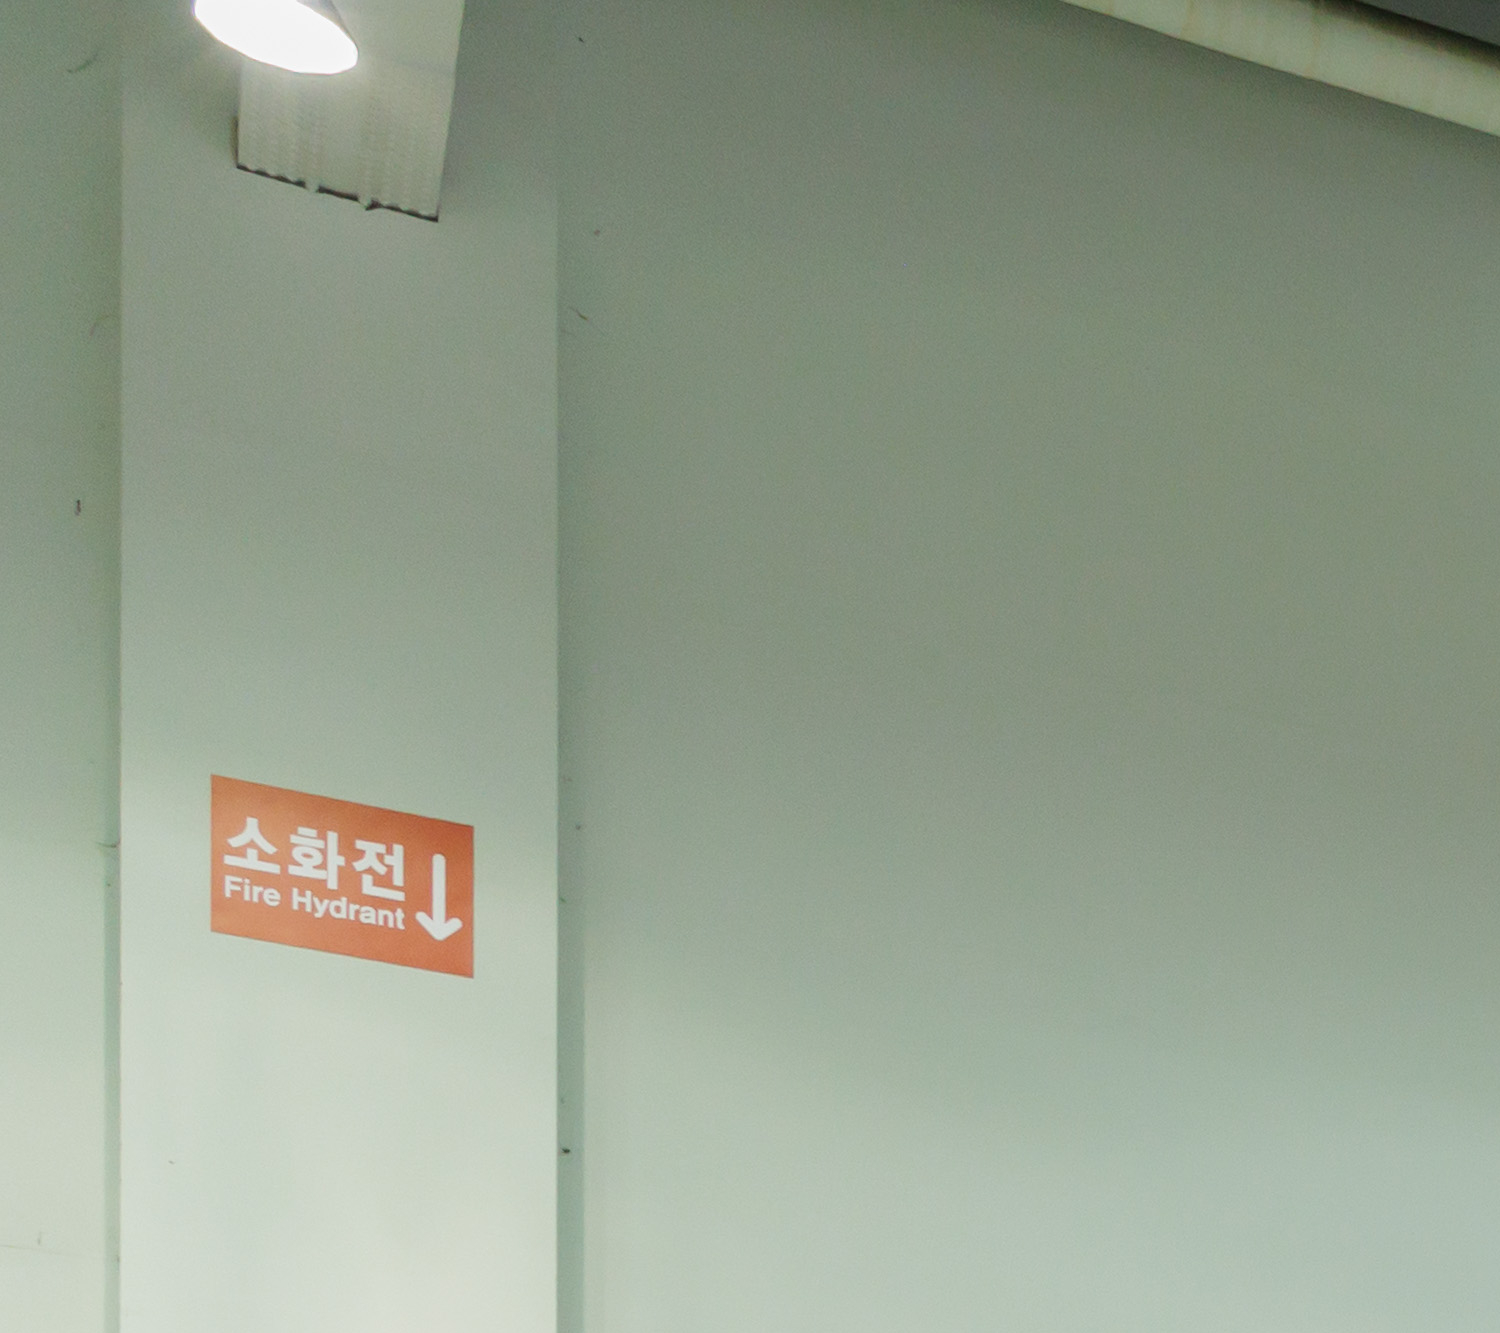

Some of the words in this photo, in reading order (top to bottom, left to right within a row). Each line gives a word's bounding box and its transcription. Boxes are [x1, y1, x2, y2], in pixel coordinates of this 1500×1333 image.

[222, 816, 406, 902] 소화전
[223, 874, 281, 907] Fire
[291, 887, 406, 930] Hydrant
